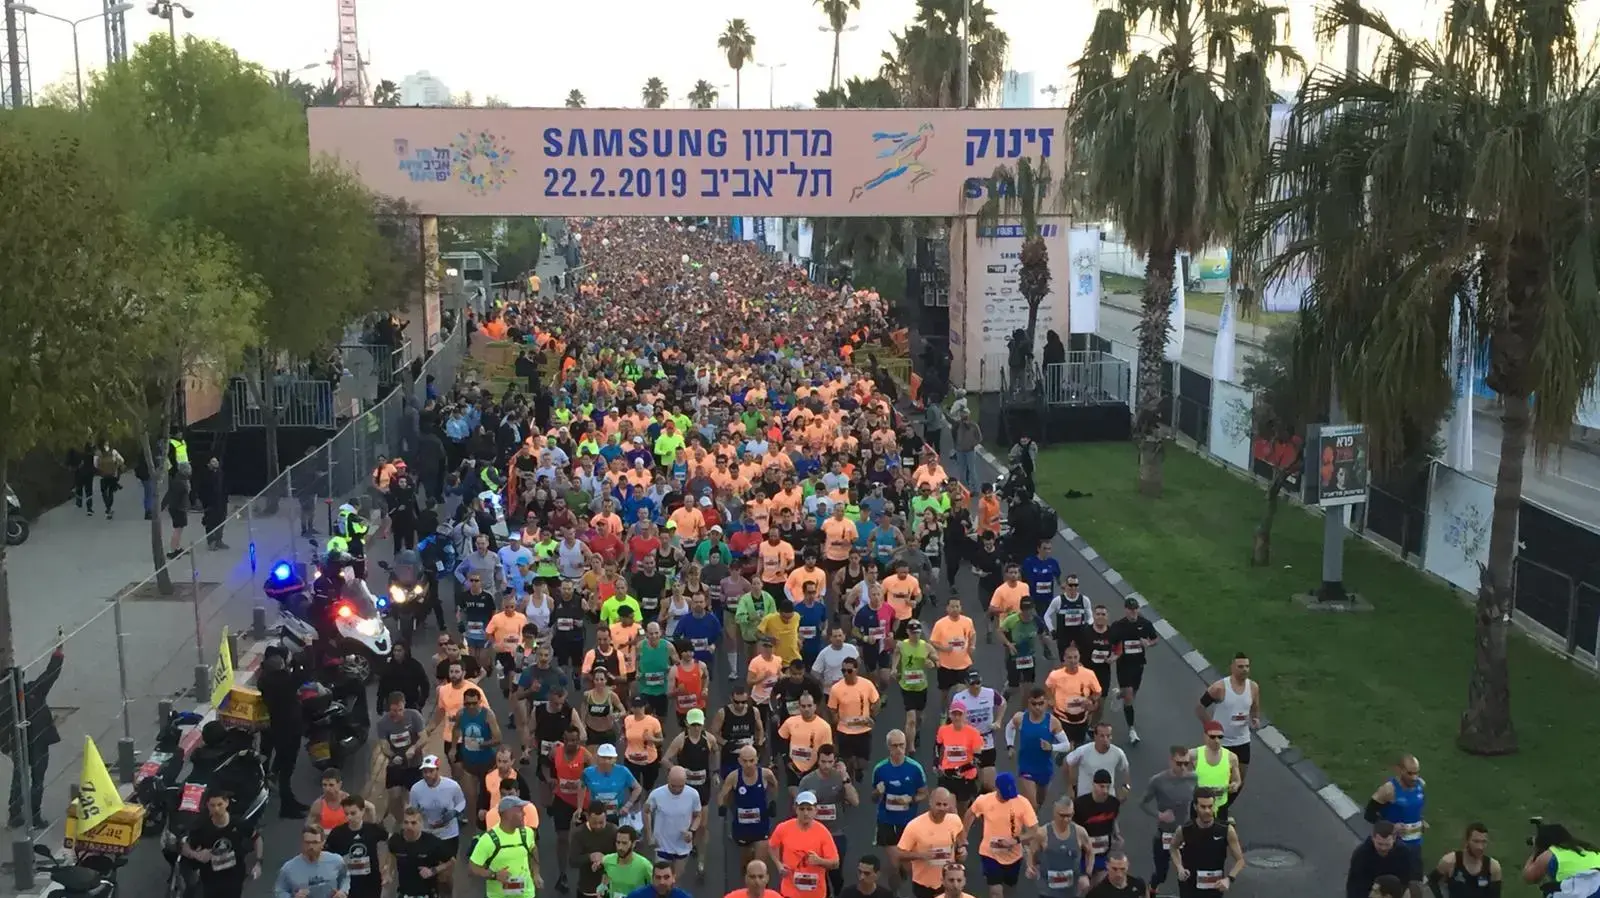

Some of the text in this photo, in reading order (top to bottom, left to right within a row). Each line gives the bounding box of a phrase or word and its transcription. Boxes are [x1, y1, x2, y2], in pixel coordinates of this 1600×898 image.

[543, 127, 832, 161] מרתון SAMSUNG
[966, 128, 1055, 166] זינוק
[543, 168, 687, 197] 22.2.2019
[1336, 436, 1354, 448] פרא
